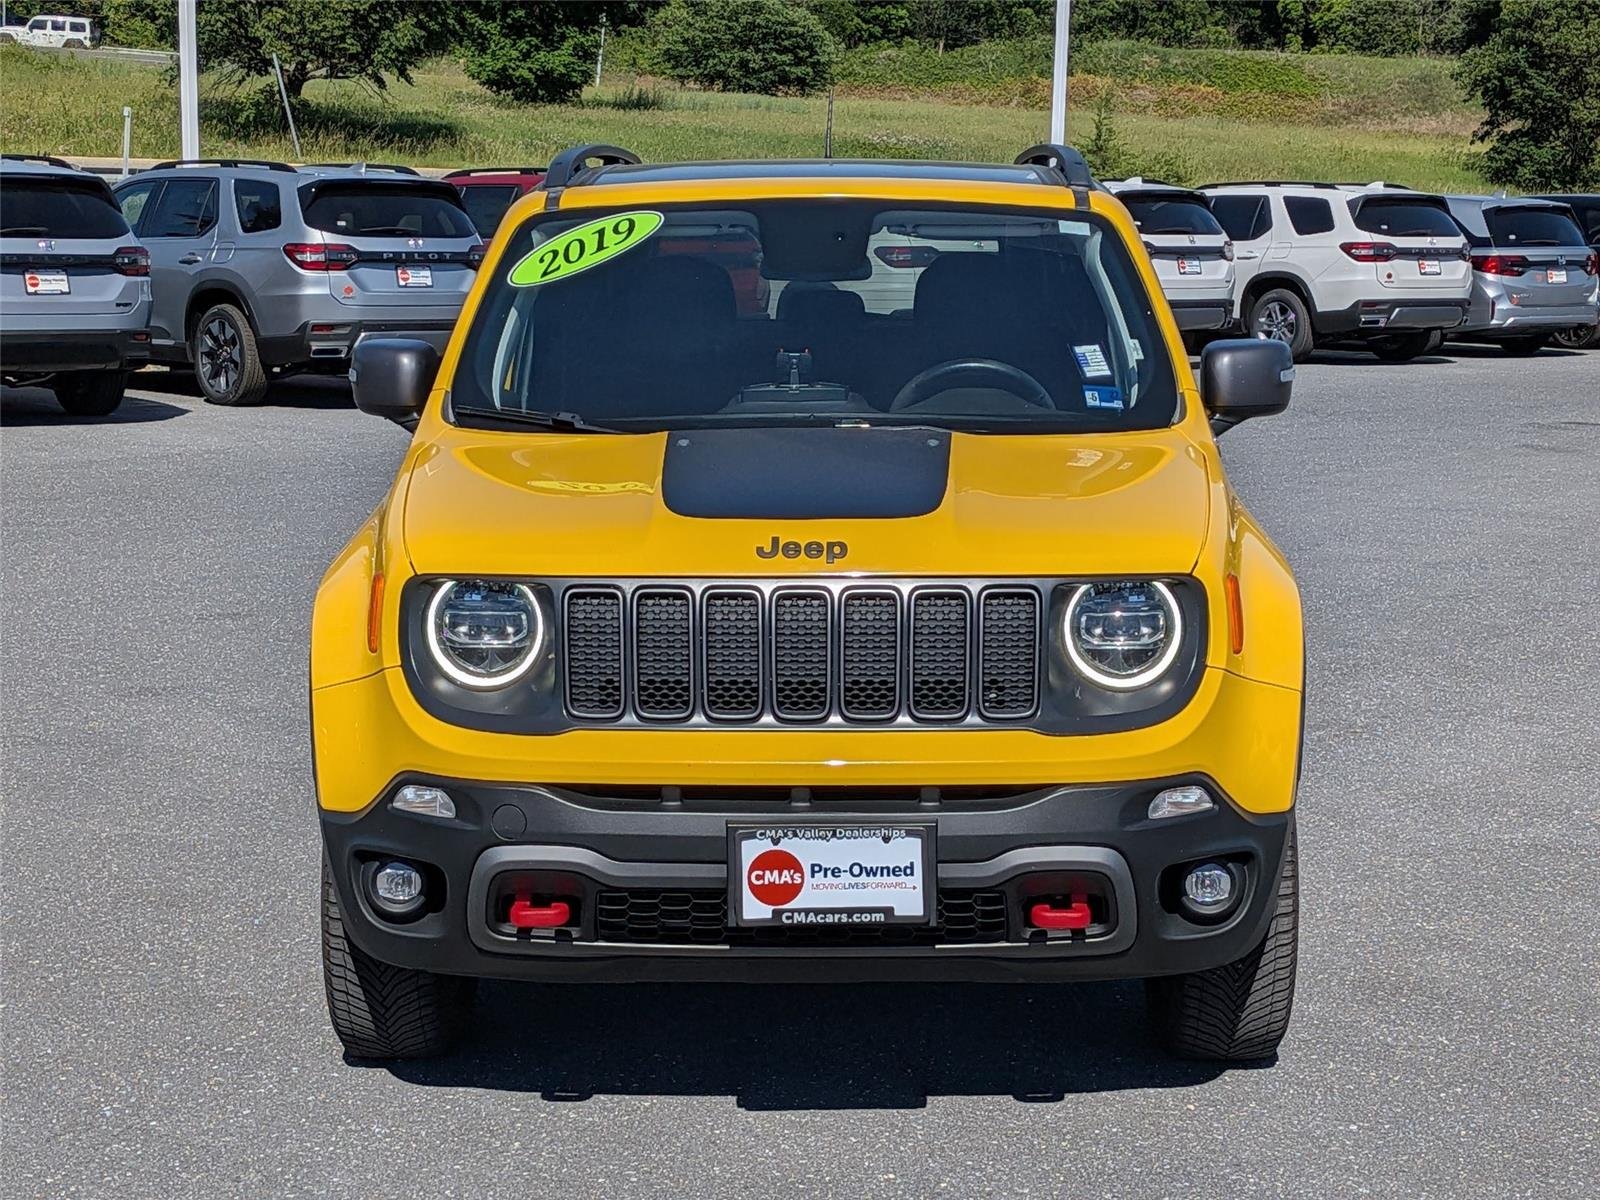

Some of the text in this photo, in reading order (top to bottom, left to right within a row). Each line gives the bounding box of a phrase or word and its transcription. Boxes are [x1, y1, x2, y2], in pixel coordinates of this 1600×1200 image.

[538, 217, 636, 279] 2019
[756, 536, 848, 564] Jeep
[756, 828, 906, 840] CMA's Valley Dealerships
[750, 869, 802, 885] CMA's
[810, 861, 915, 878] Pre-Owned
[781, 911, 885, 924] CMAcars.com
